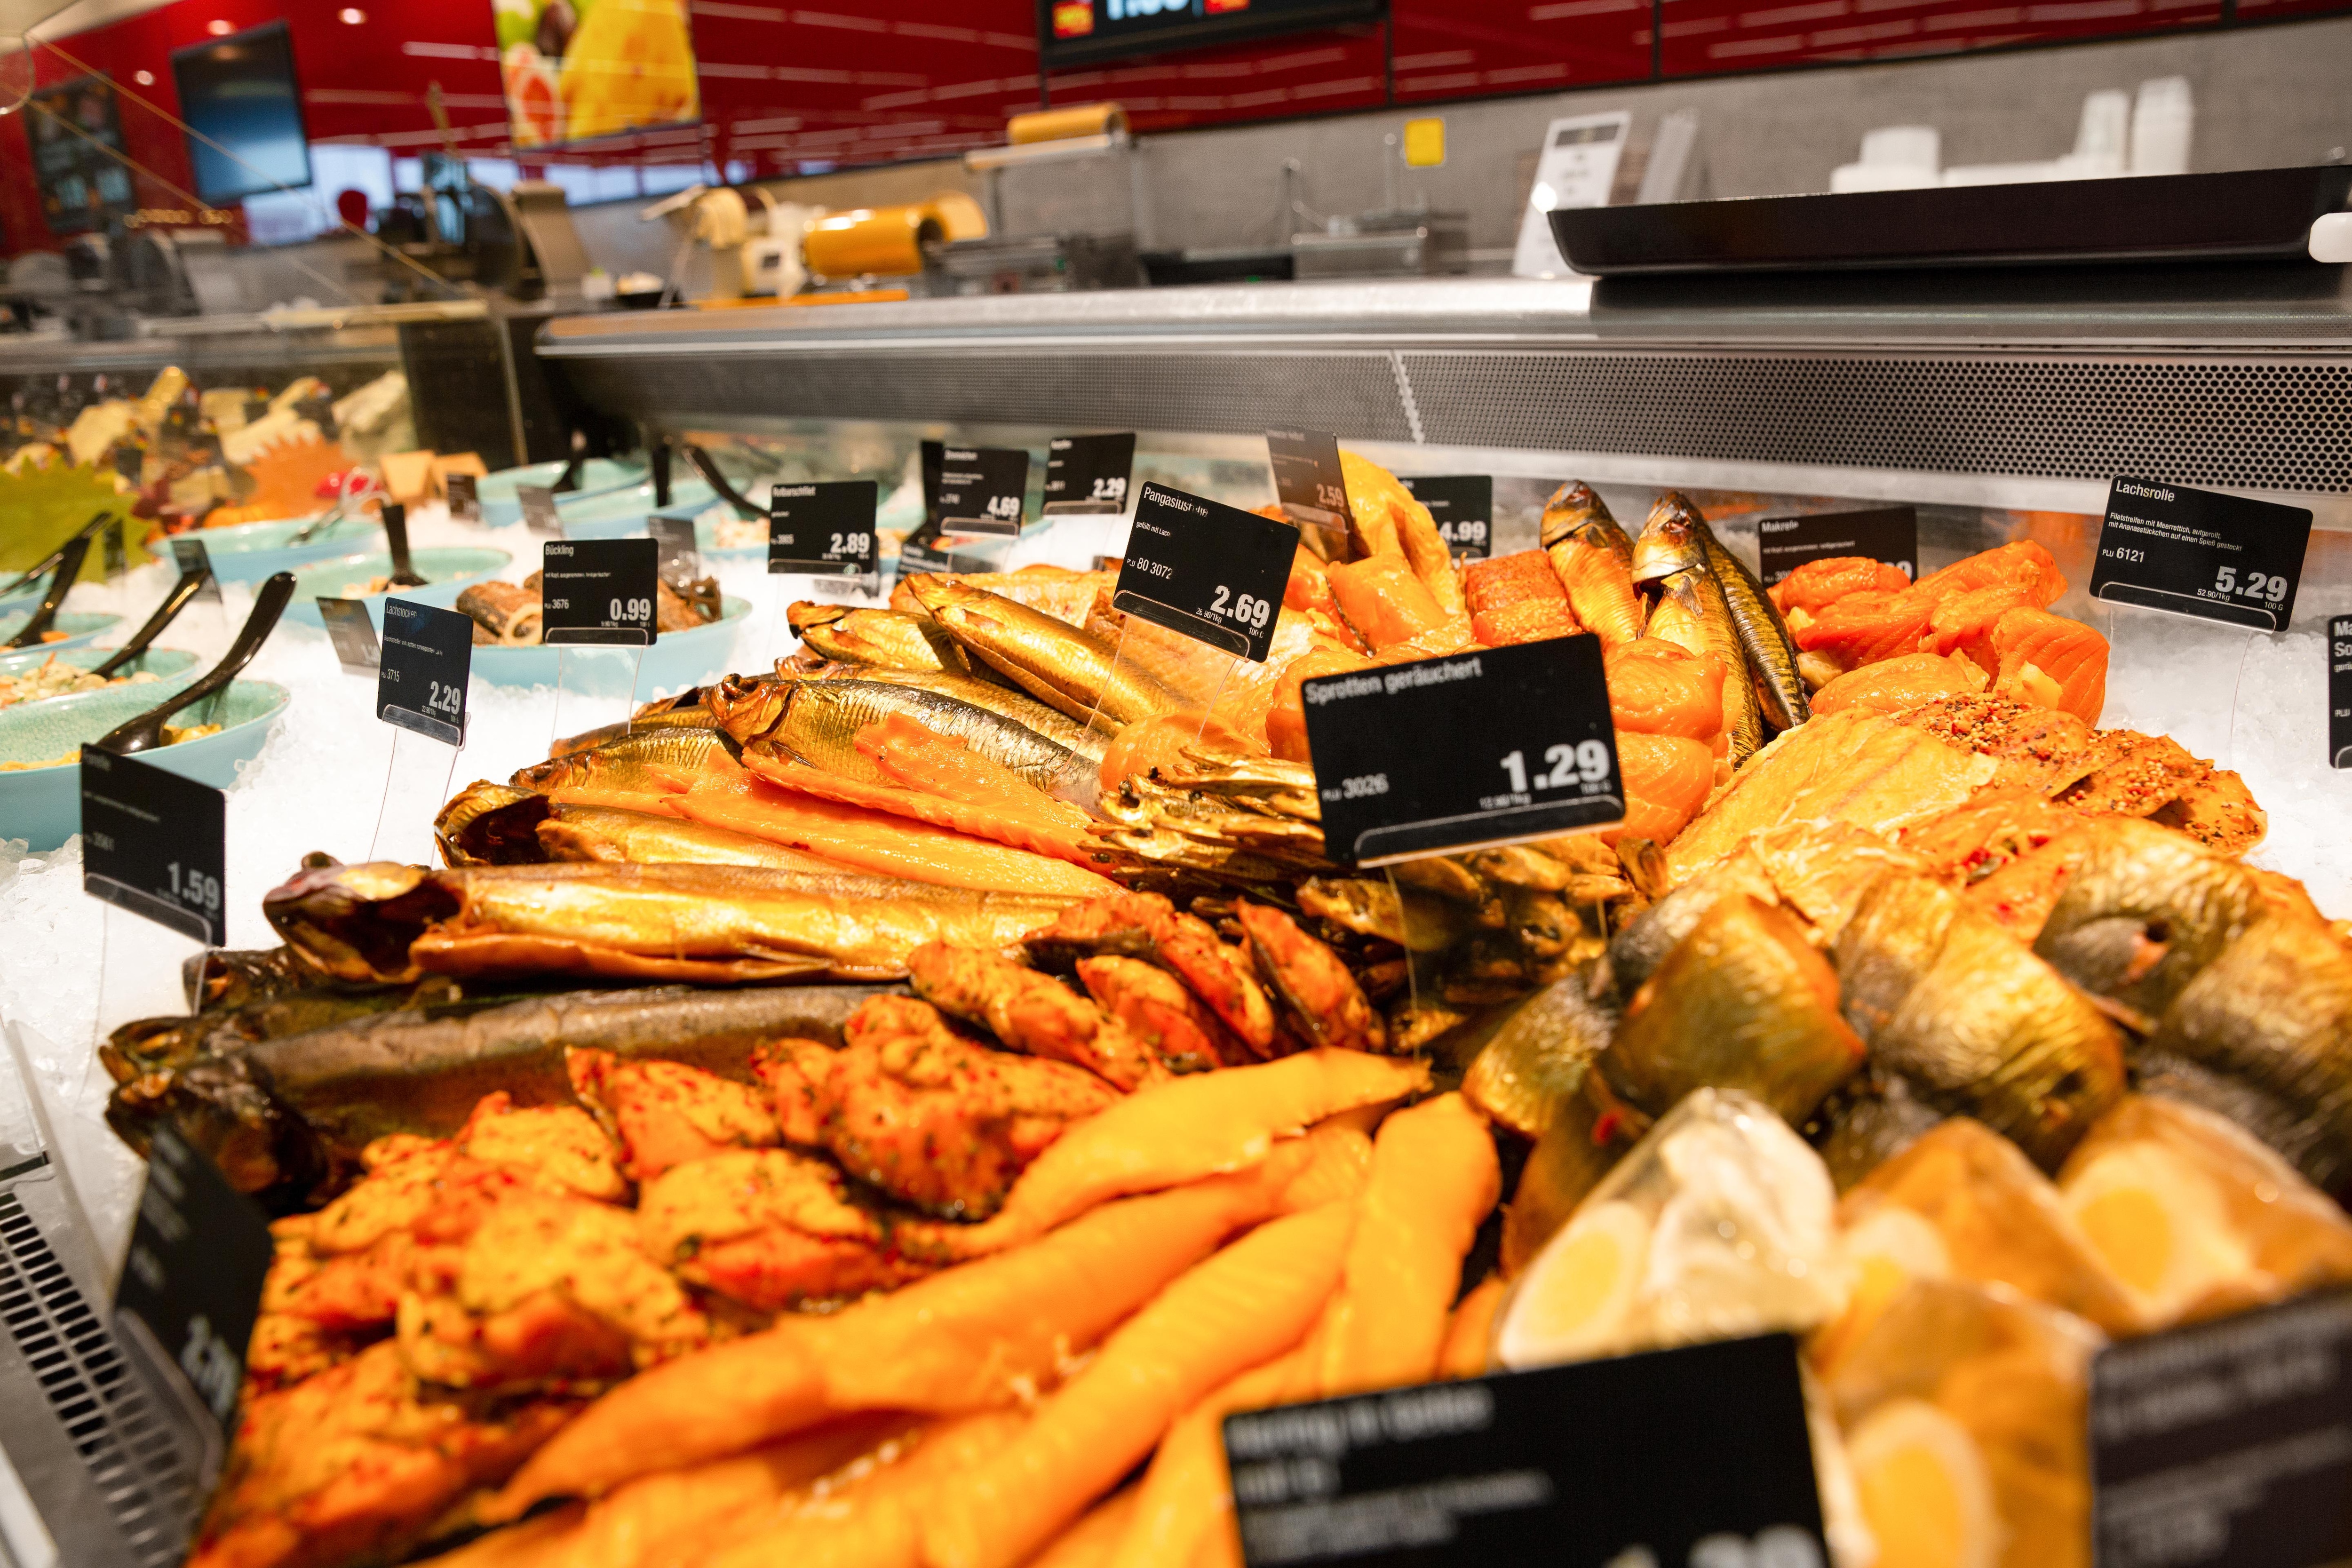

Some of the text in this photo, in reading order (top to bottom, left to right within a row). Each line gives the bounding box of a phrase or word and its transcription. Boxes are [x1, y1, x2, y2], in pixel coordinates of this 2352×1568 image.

[2116, 480, 2175, 501] Lachsrolle
[1136, 521, 1151, 531] gefüllt
[1439, 520, 1487, 541] 4.99
[2110, 512, 2144, 525] Filetstreifen
[2156, 521, 2191, 533] Meerrettich,
[830, 532, 870, 554] 2.89
[2119, 523, 2169, 537] Ananasstückchen
[2199, 537, 2216, 546] Spieß
[2217, 541, 2242, 551] gesteckt
[545, 545, 574, 557] Bückling
[2116, 547, 2145, 563] 6121
[1136, 557, 1149, 571] 80
[1150, 562, 1173, 579] 3072
[2215, 566, 2288, 602] 5.29
[552, 598, 569, 609] 3676
[2197, 589, 2230, 602] 52.90/1kg
[2265, 601, 2276, 610] 100
[610, 598, 651, 621] 0.99
[1196, 607, 1222, 624] 2690/1kg
[1210, 585, 1270, 629] 2.69
[387, 669, 400, 682] 3715
[1304, 656, 1483, 706] Sprotten geräuchert
[429, 681, 461, 715] 2.29
[1500, 739, 1610, 793] 1.29
[1342, 772, 1390, 799] 3026
[167, 862, 220, 911] 1.59
